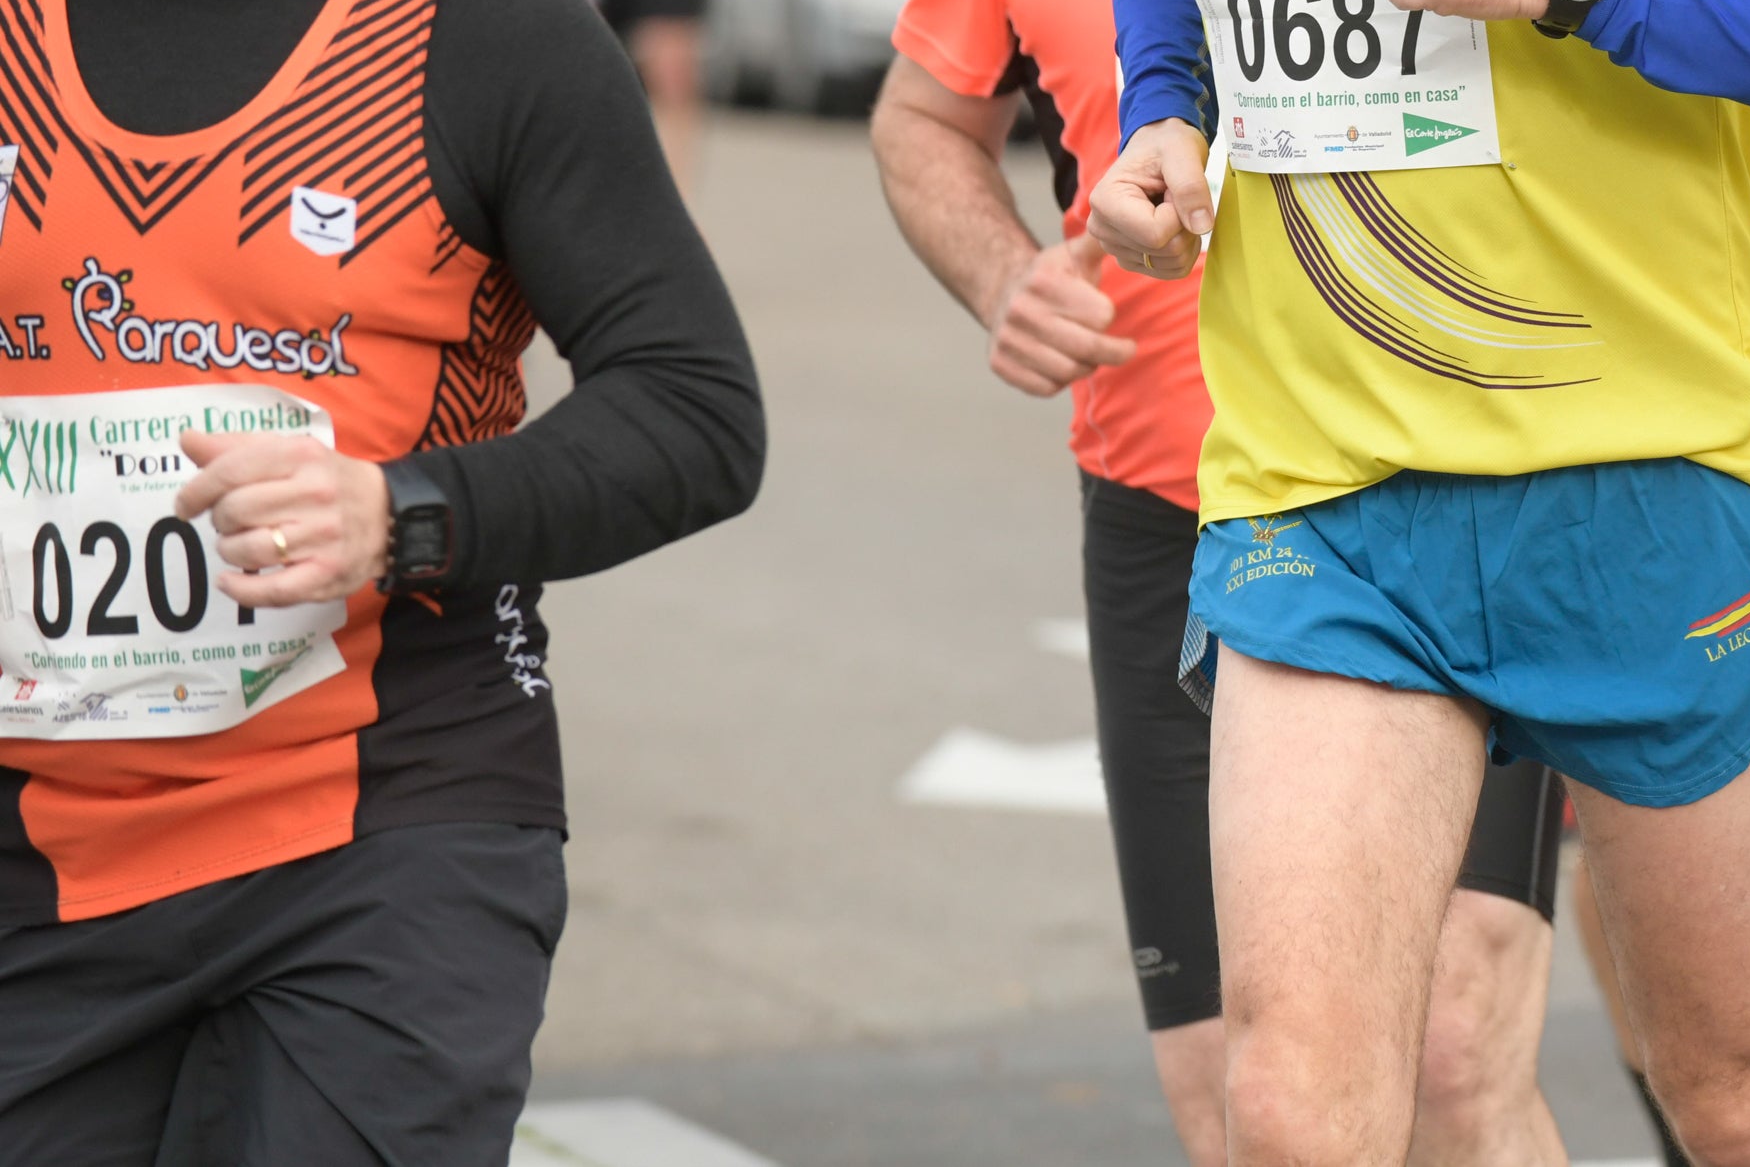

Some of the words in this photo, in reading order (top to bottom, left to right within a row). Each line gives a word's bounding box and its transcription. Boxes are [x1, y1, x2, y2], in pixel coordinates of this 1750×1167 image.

[1281, 95, 1295, 108] en
[1300, 91, 1312, 107] el
[1317, 90, 1360, 107] barrio,
[1365, 91, 1399, 105] como
[1404, 88, 1421, 103] en
[70, 256, 360, 377] Parquesol
[90, 414, 192, 446] Carrera
[1247, 547, 1272, 564] KM
[1226, 572, 1244, 594] XXI
[1246, 560, 1316, 582] EDICIÓN
[91, 653, 108, 669] en
[114, 648, 128, 667] el
[192, 645, 236, 662] como
[242, 642, 262, 658] en
[1704, 643, 1727, 662] LA
